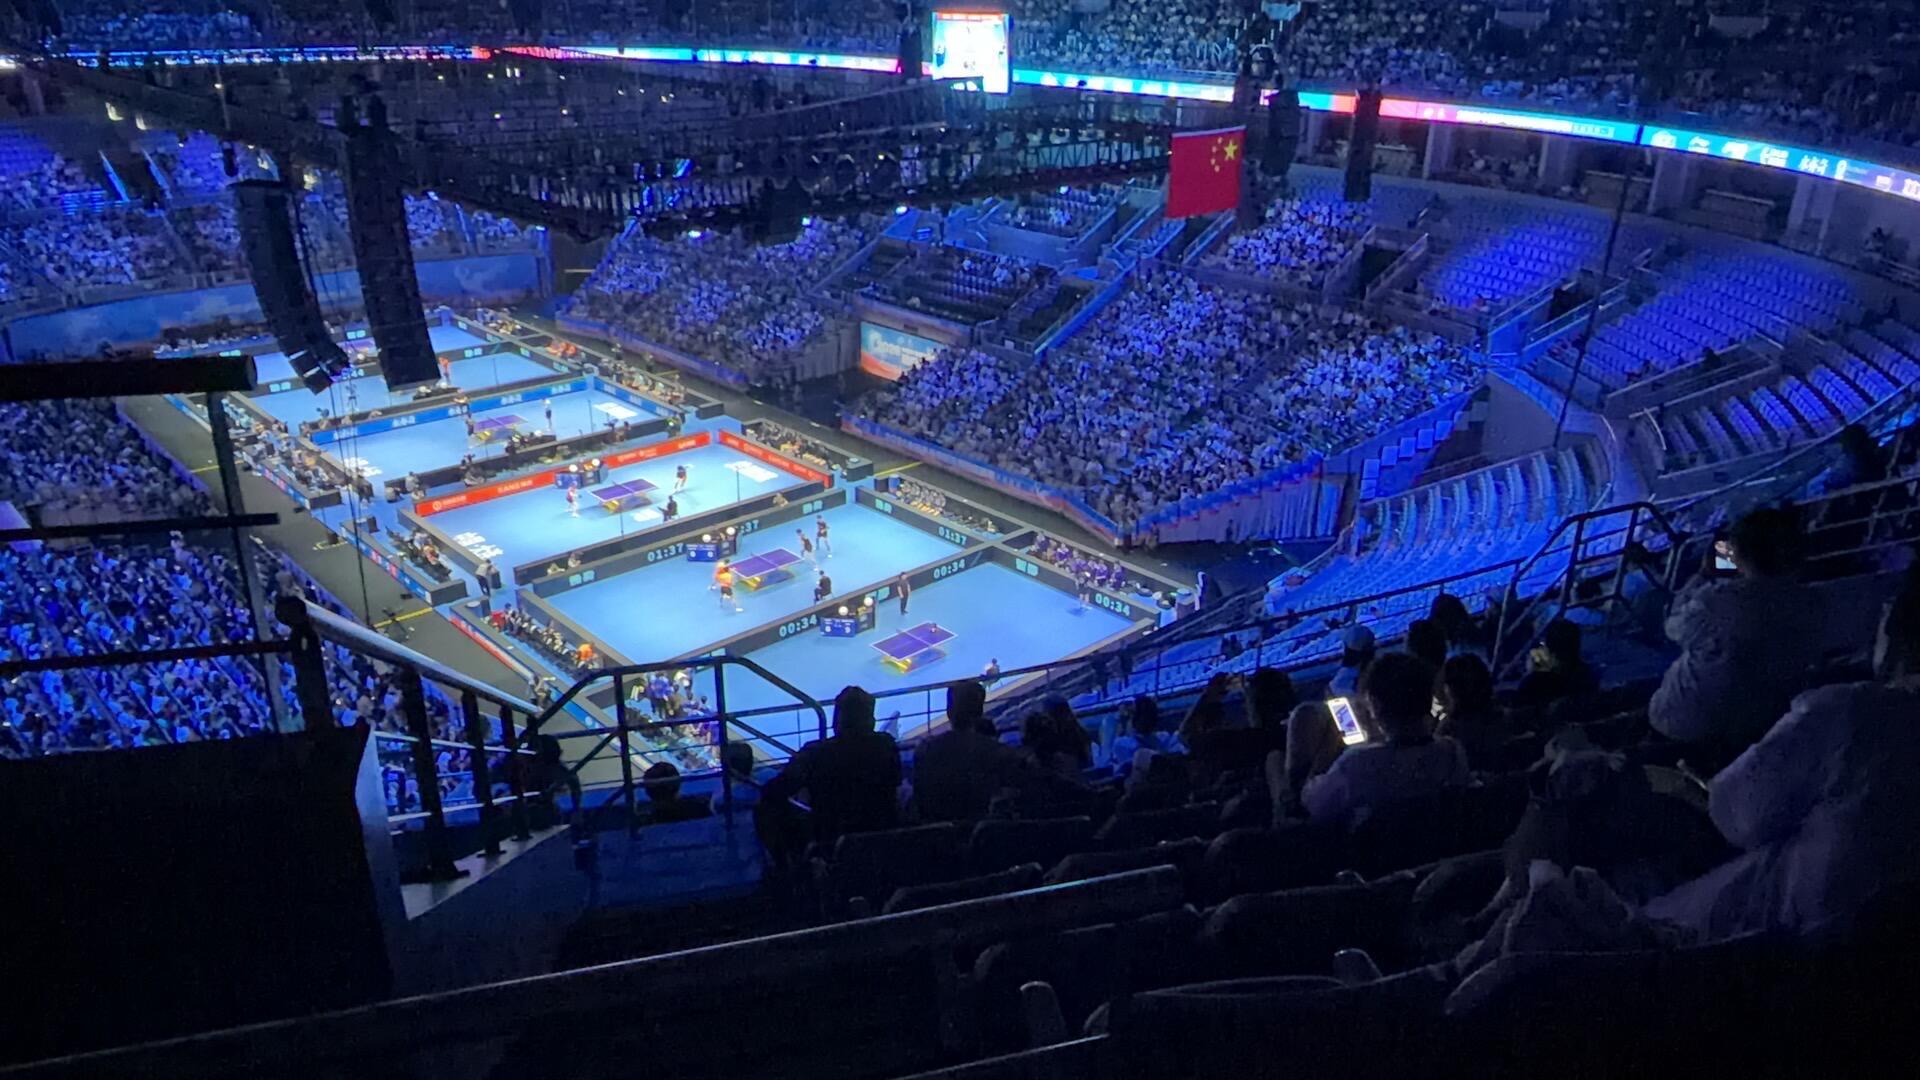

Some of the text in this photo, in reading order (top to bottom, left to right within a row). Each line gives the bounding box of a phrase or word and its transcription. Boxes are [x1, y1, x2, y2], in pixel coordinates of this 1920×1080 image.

[938, 526, 967, 546] 01:37
[647, 543, 684, 562] 01:37
[933, 558, 966, 579] 00:34
[1095, 593, 1131, 617] 00:34
[779, 614, 817, 638] 00:34
